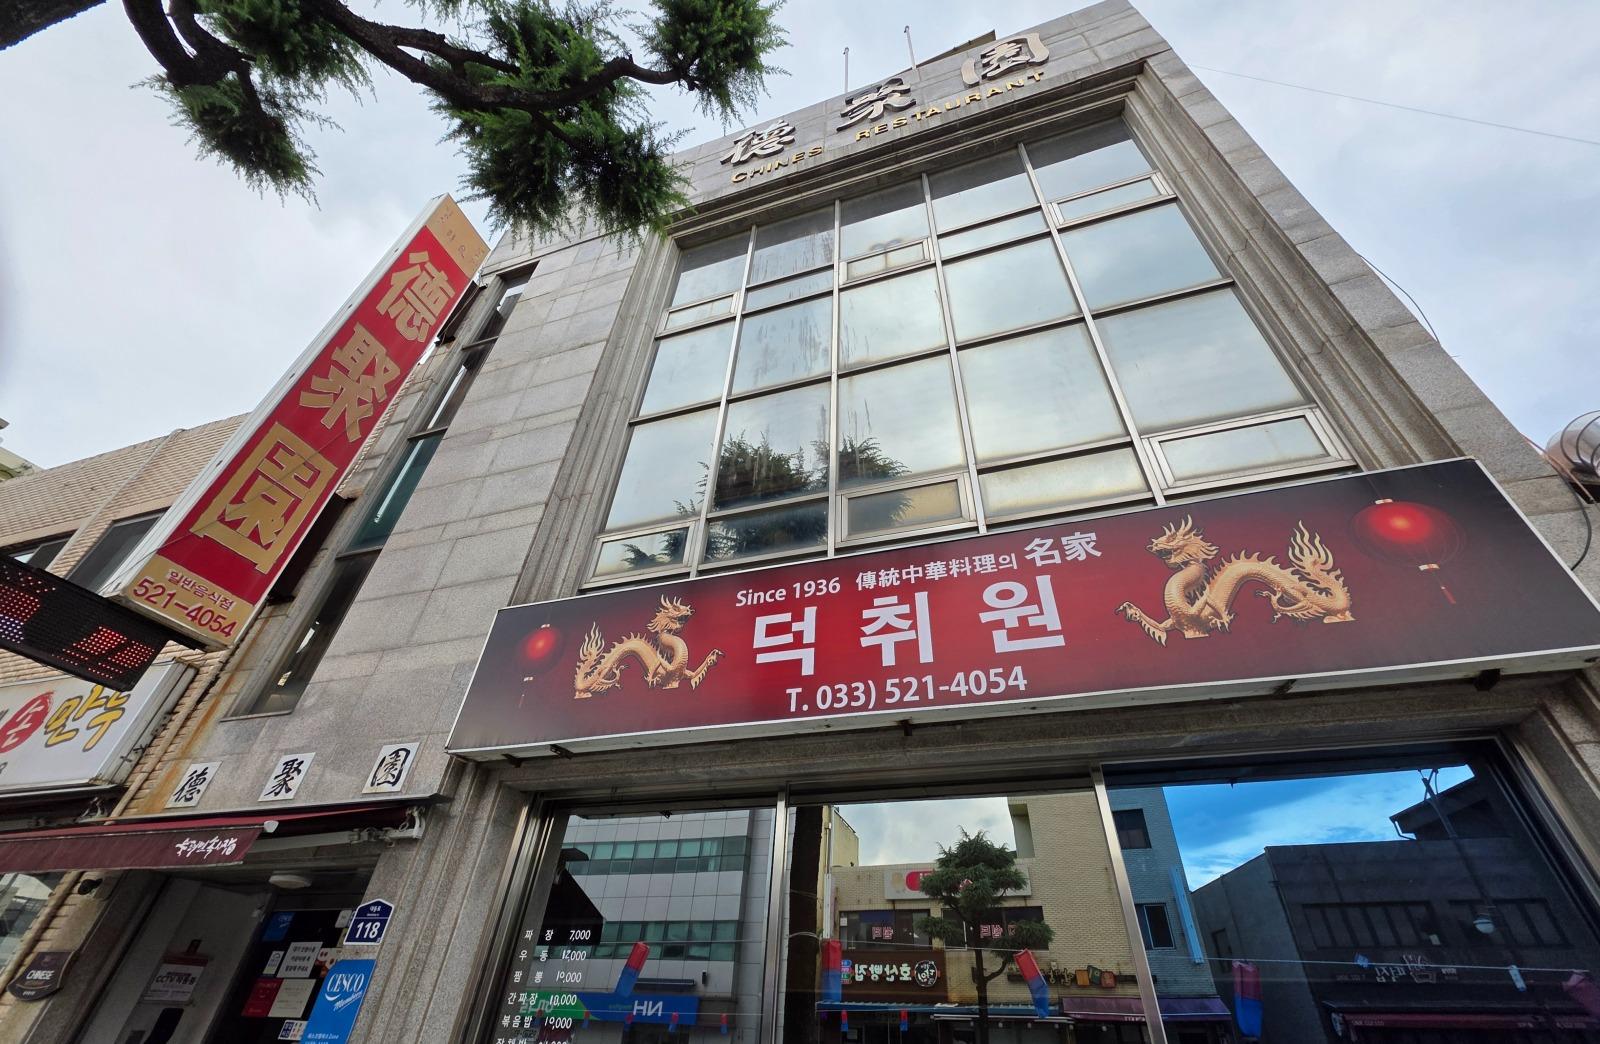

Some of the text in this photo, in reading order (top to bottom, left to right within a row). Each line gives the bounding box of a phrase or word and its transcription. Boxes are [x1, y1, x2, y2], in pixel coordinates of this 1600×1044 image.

[731, 71, 1044, 184] CHINES RESTAURANT
[167, 570, 234, 611] 일반음식점
[735, 532, 1102, 608] Since 1936 傳統中華料理의 名家
[133, 578, 237, 638] 521-4054
[785, 665, 1028, 712] T. 033) 521-4054
[355, 921, 381, 939] 118
[569, 929, 591, 942] 7,000
[326, 973, 365, 993] CESCO
